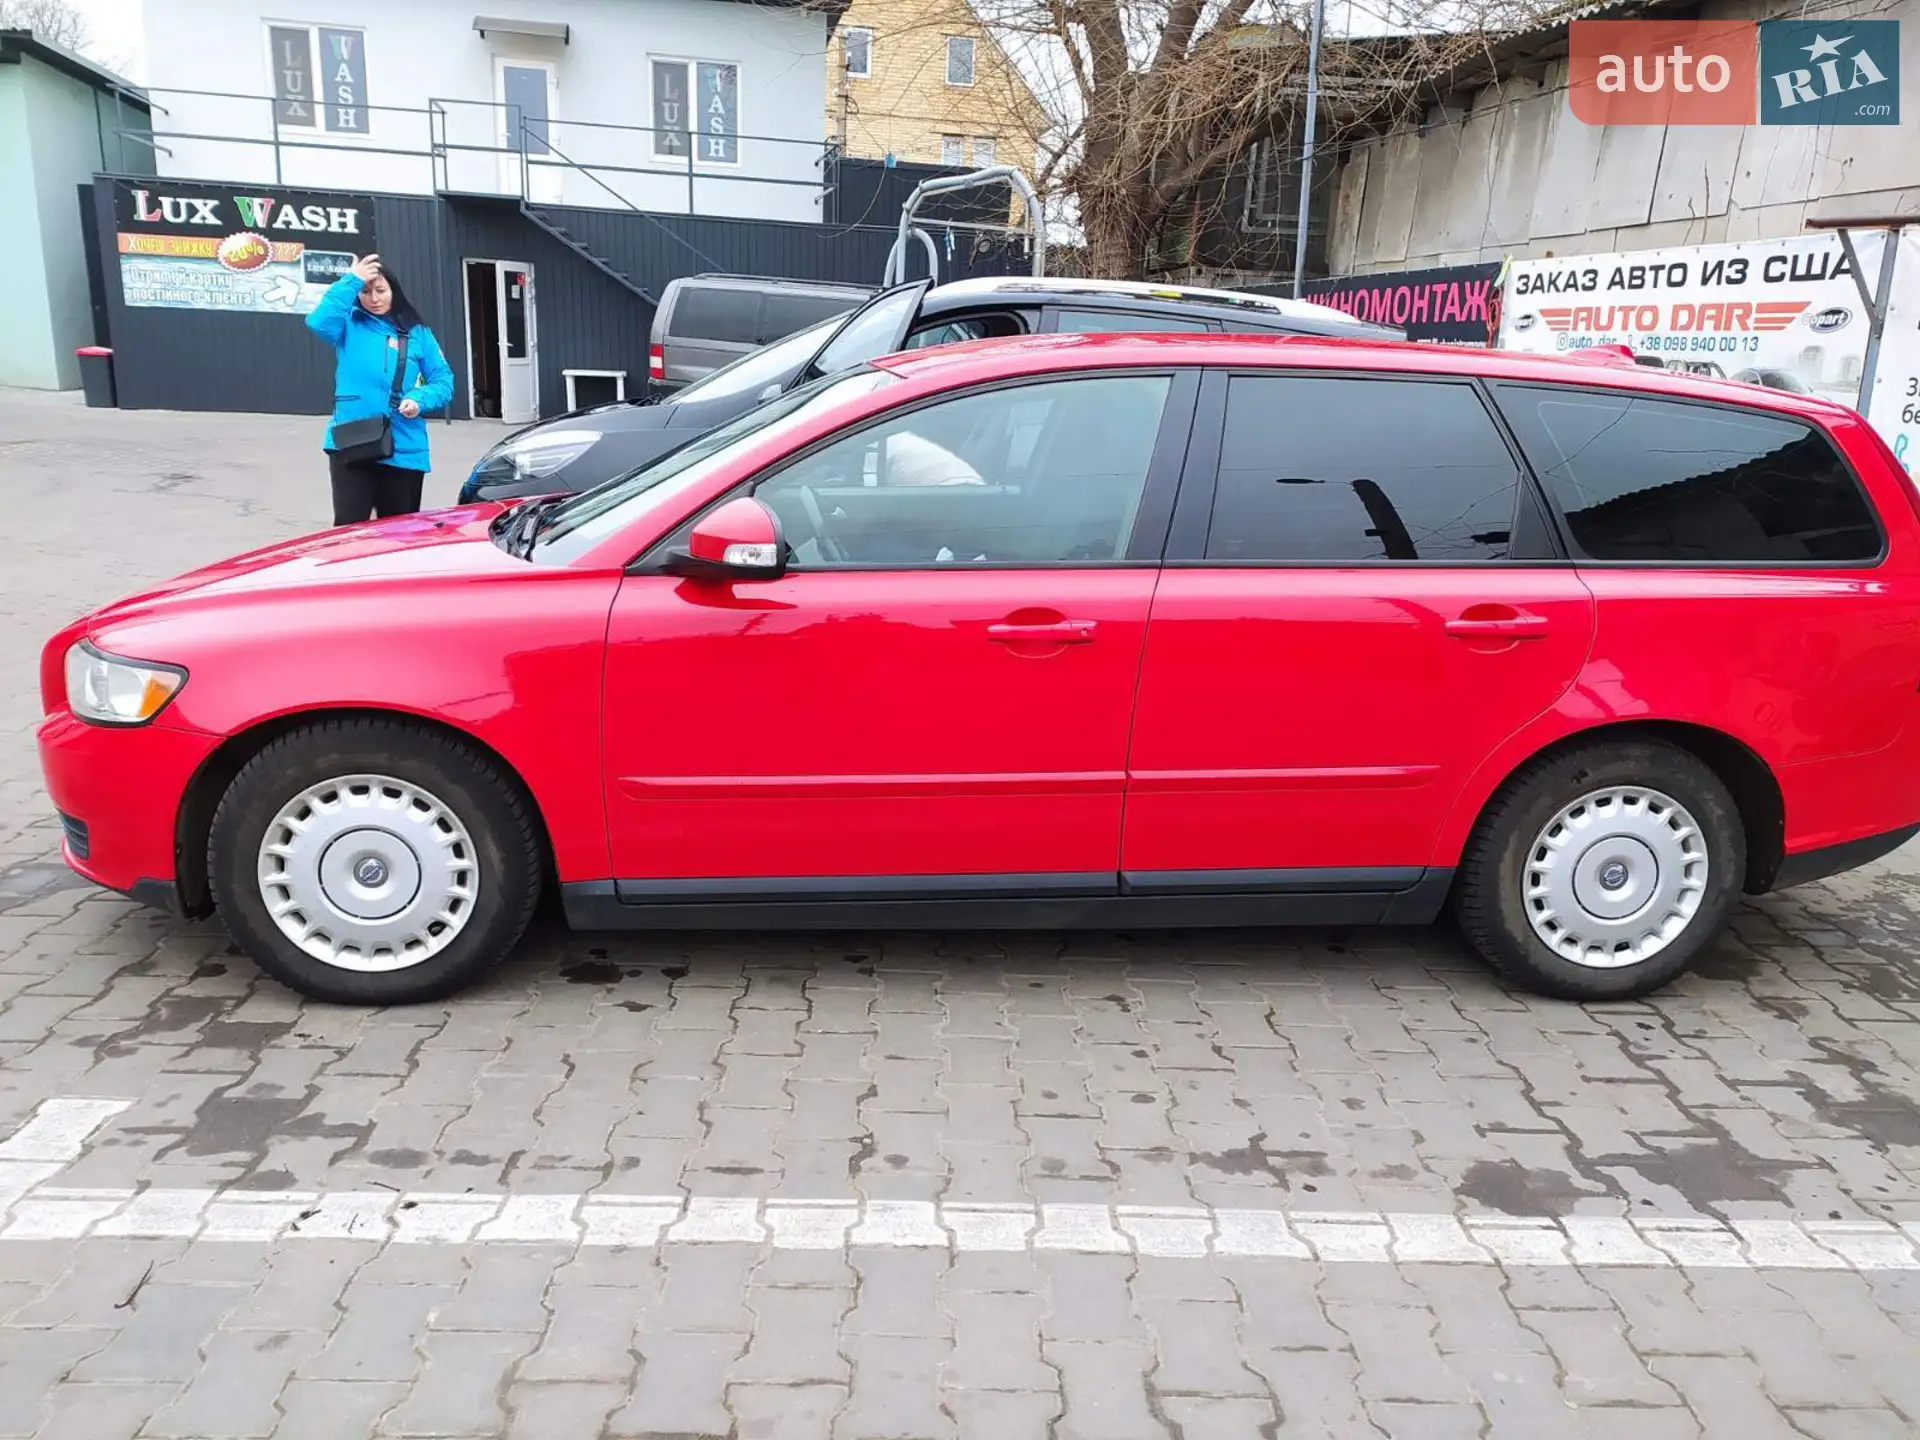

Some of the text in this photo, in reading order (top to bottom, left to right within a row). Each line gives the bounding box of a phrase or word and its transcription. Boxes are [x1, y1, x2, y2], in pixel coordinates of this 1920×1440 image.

[282, 40, 308, 116] LUX
[328, 35, 357, 128] WASH
[704, 66, 727, 158] WASH
[131, 189, 359, 234] LUX WASH
[1516, 252, 1855, 295] ЗАКАЗ АВТО ИЗ США
[1571, 303, 1753, 331] AUTO DAR
[1640, 336, 1661, 350] +38
[1664, 337, 1688, 351] 098
[1691, 337, 1716, 351] 940
[1719, 337, 1737, 352] 00
[1742, 336, 1759, 351] 13
